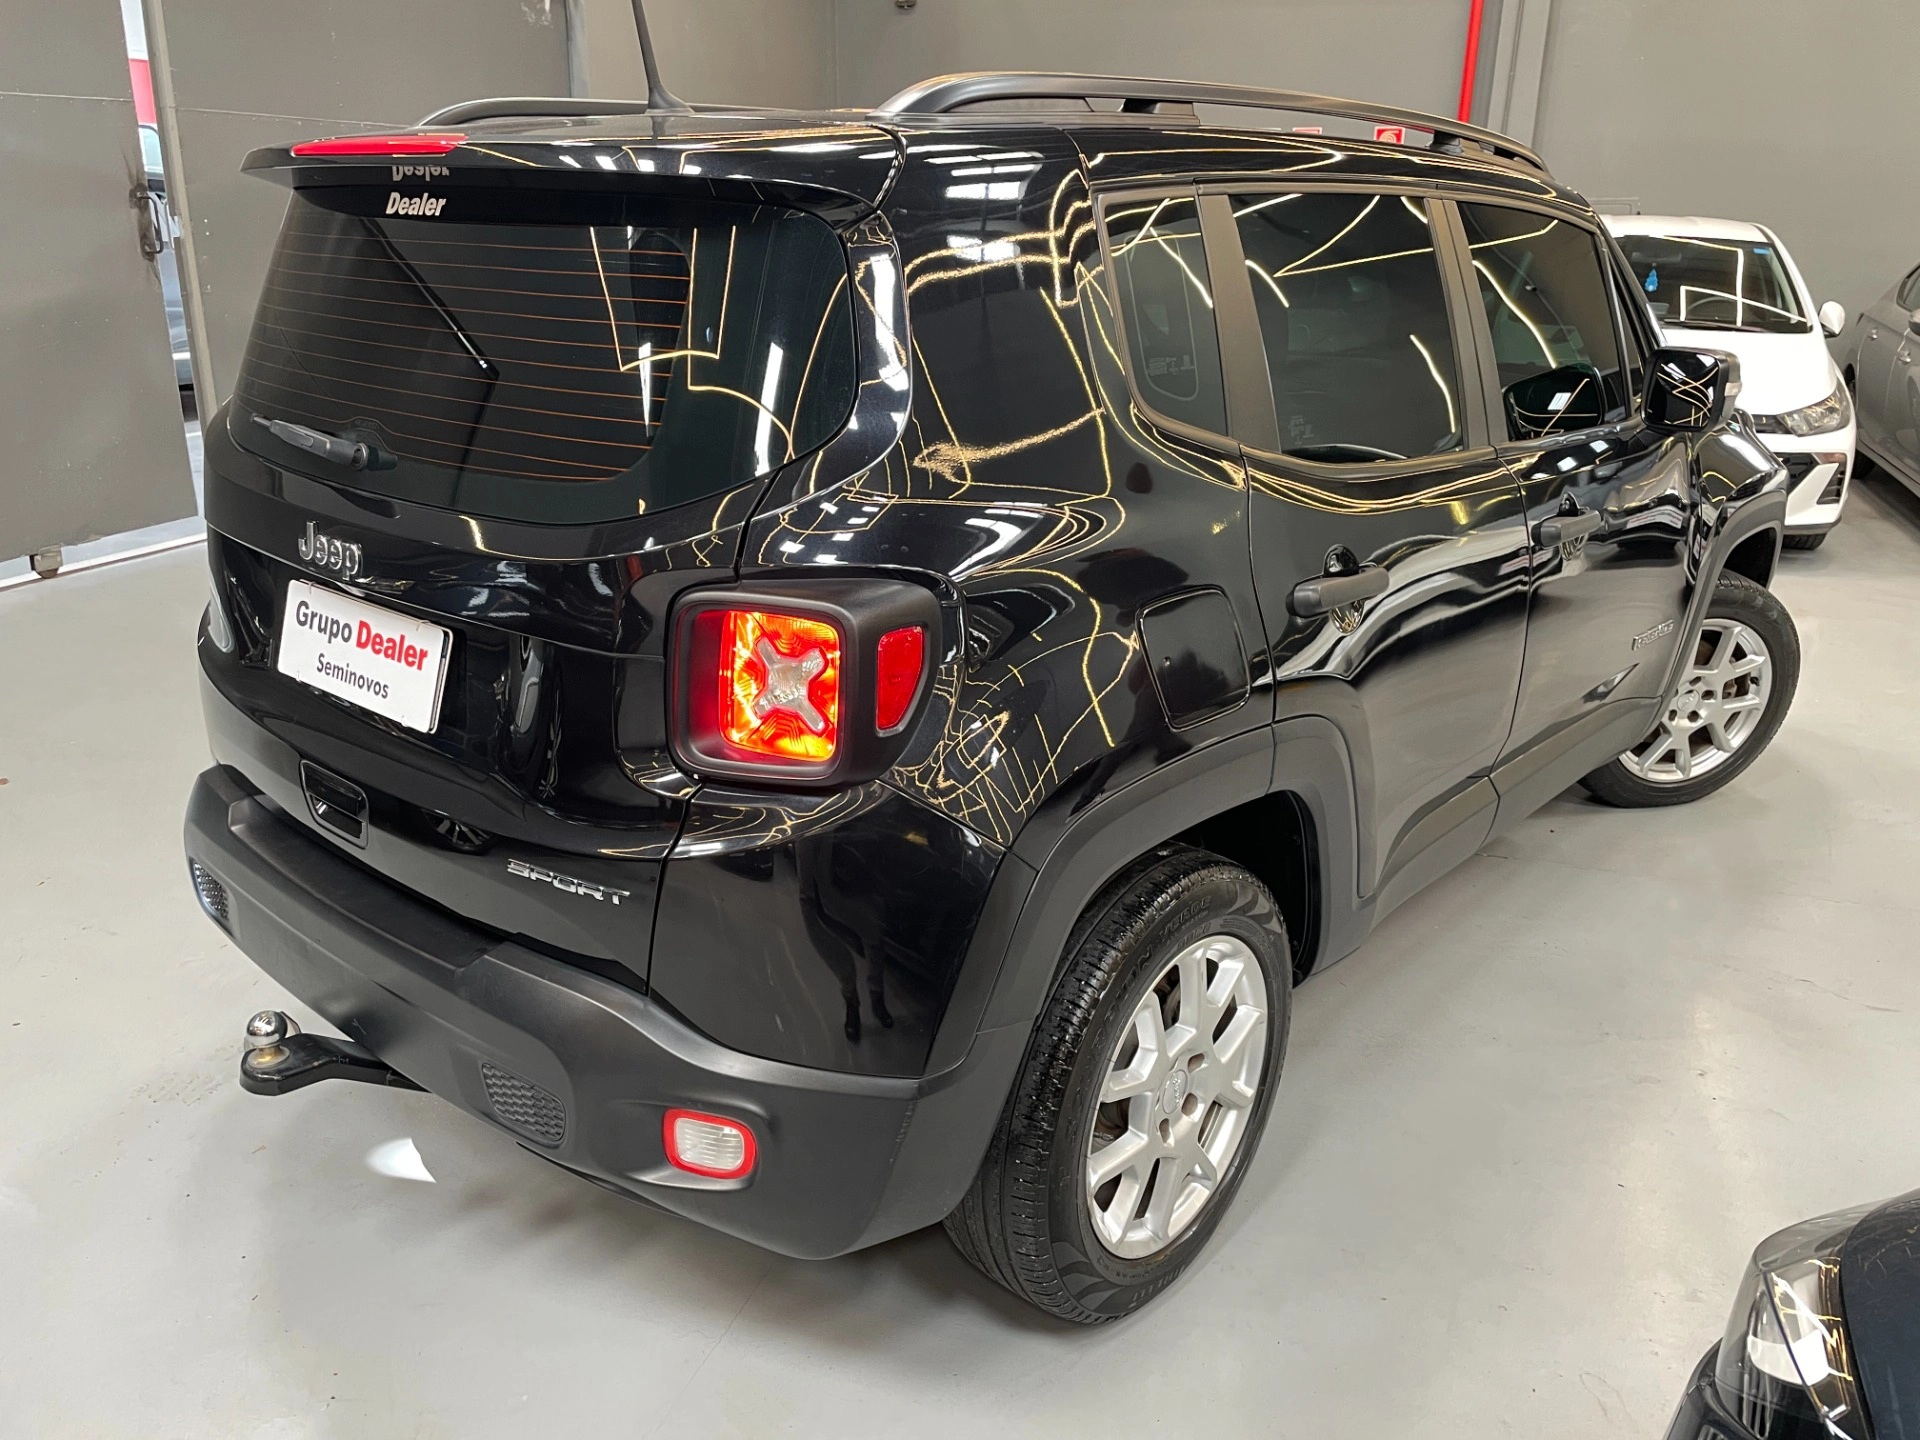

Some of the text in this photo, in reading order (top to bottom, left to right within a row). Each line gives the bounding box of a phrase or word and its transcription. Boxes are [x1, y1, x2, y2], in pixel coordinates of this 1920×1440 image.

[385, 191, 447, 217] Dealer
[297, 520, 364, 581] Jeep
[296, 600, 429, 671] Grupo Dealer
[316, 652, 390, 699] Seminovos
[506, 858, 630, 906] SPORT
